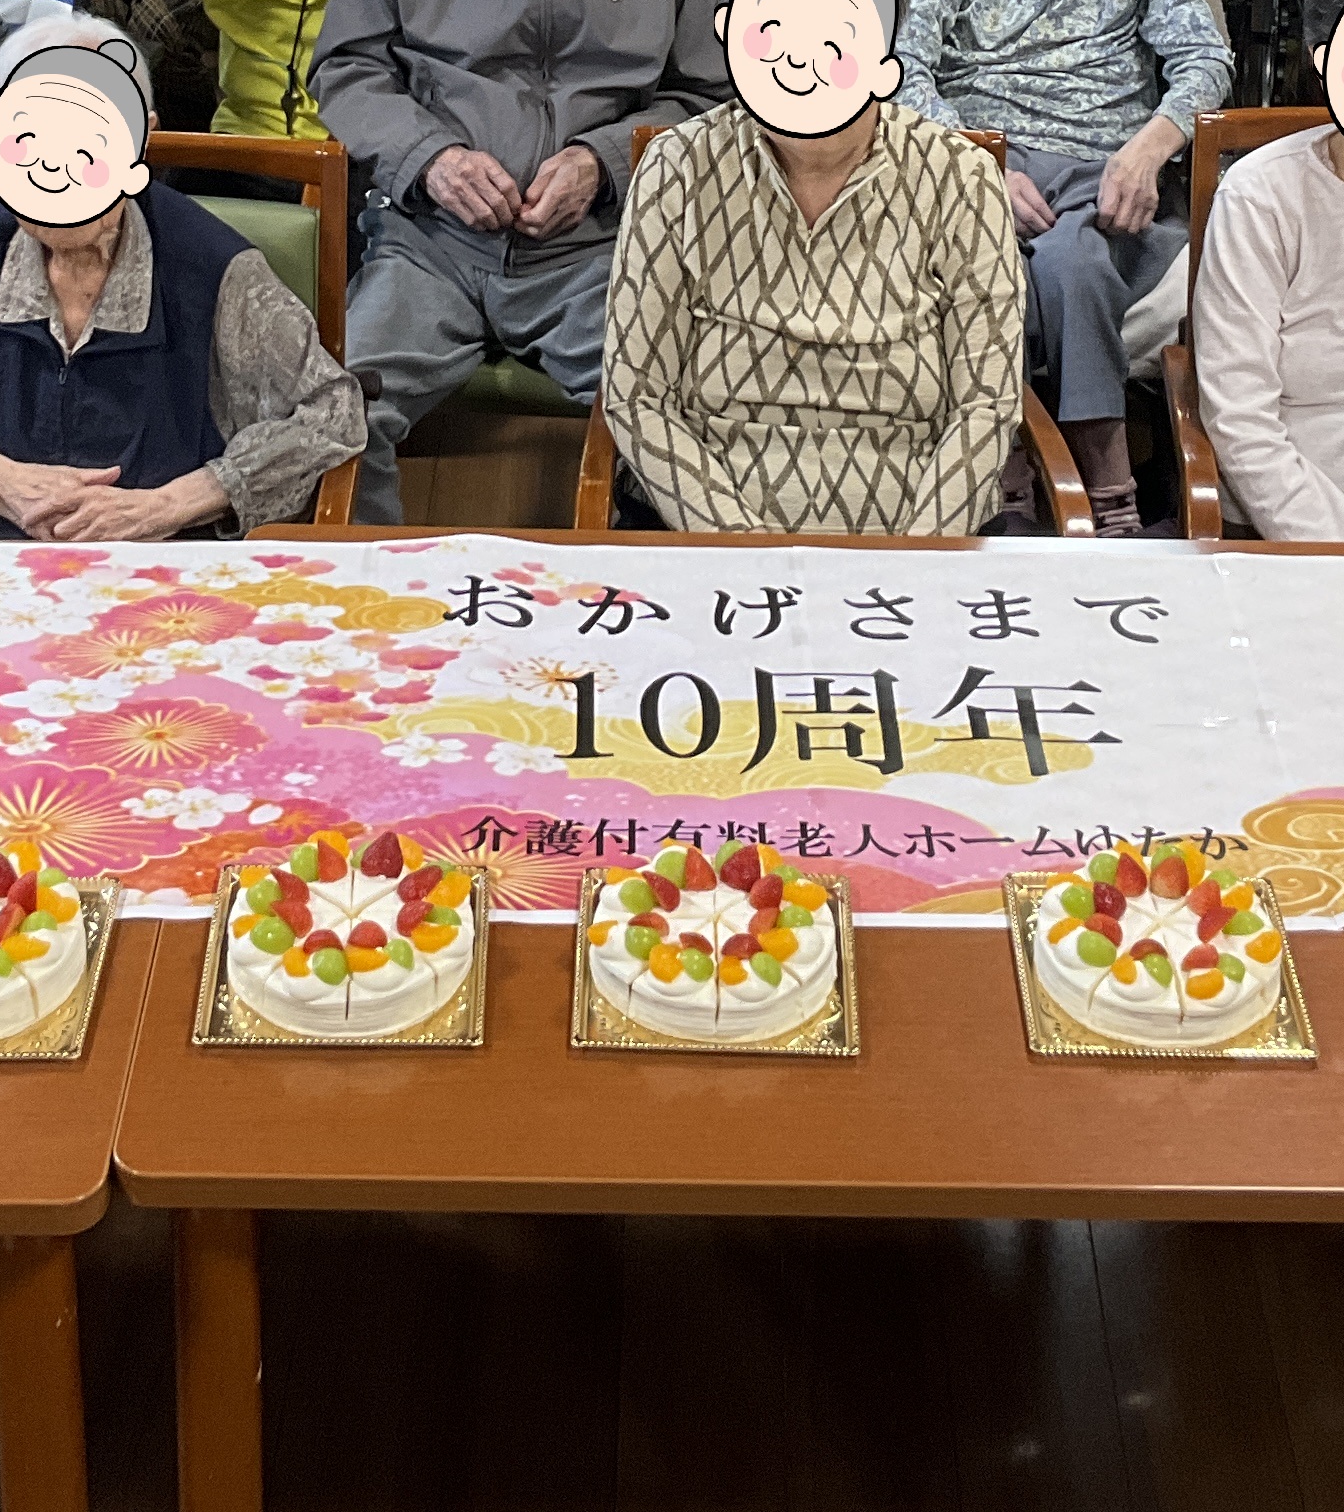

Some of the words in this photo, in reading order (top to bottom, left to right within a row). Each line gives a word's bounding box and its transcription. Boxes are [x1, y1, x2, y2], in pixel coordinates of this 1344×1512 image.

[442, 574, 1171, 645] おかげさまで
[554, 664, 1124, 774] 10周年
